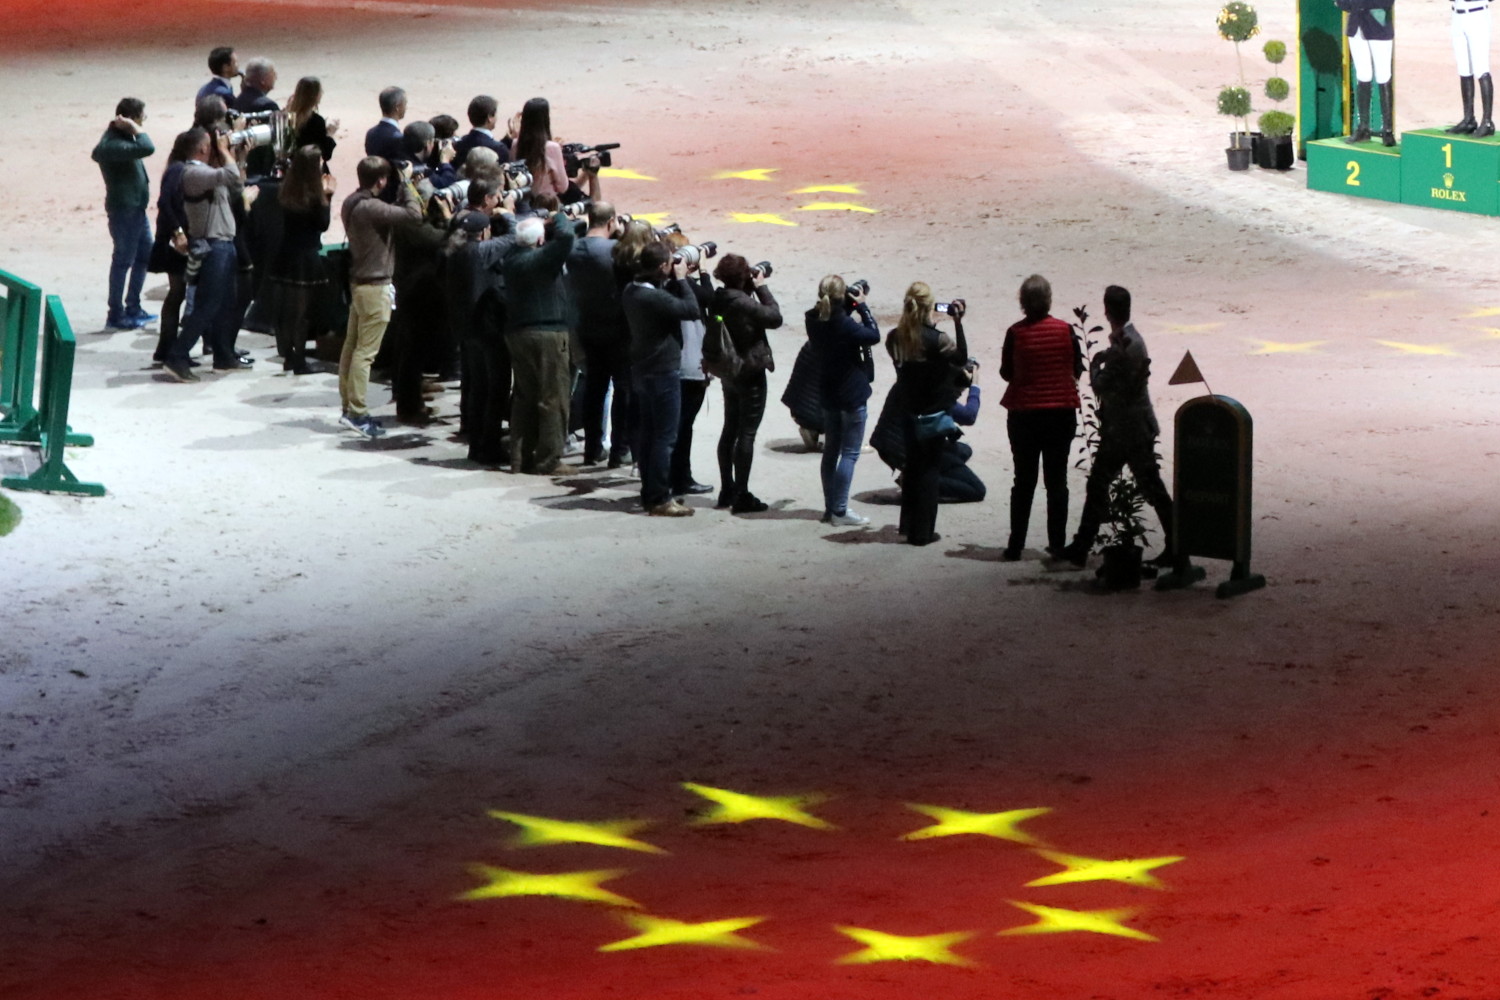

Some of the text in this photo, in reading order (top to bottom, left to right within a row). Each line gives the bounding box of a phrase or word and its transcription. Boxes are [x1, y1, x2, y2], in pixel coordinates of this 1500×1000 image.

[1441, 143, 1452, 169] 1
[1345, 160, 1361, 186] 2
[1431, 187, 1466, 202] ROLEX
